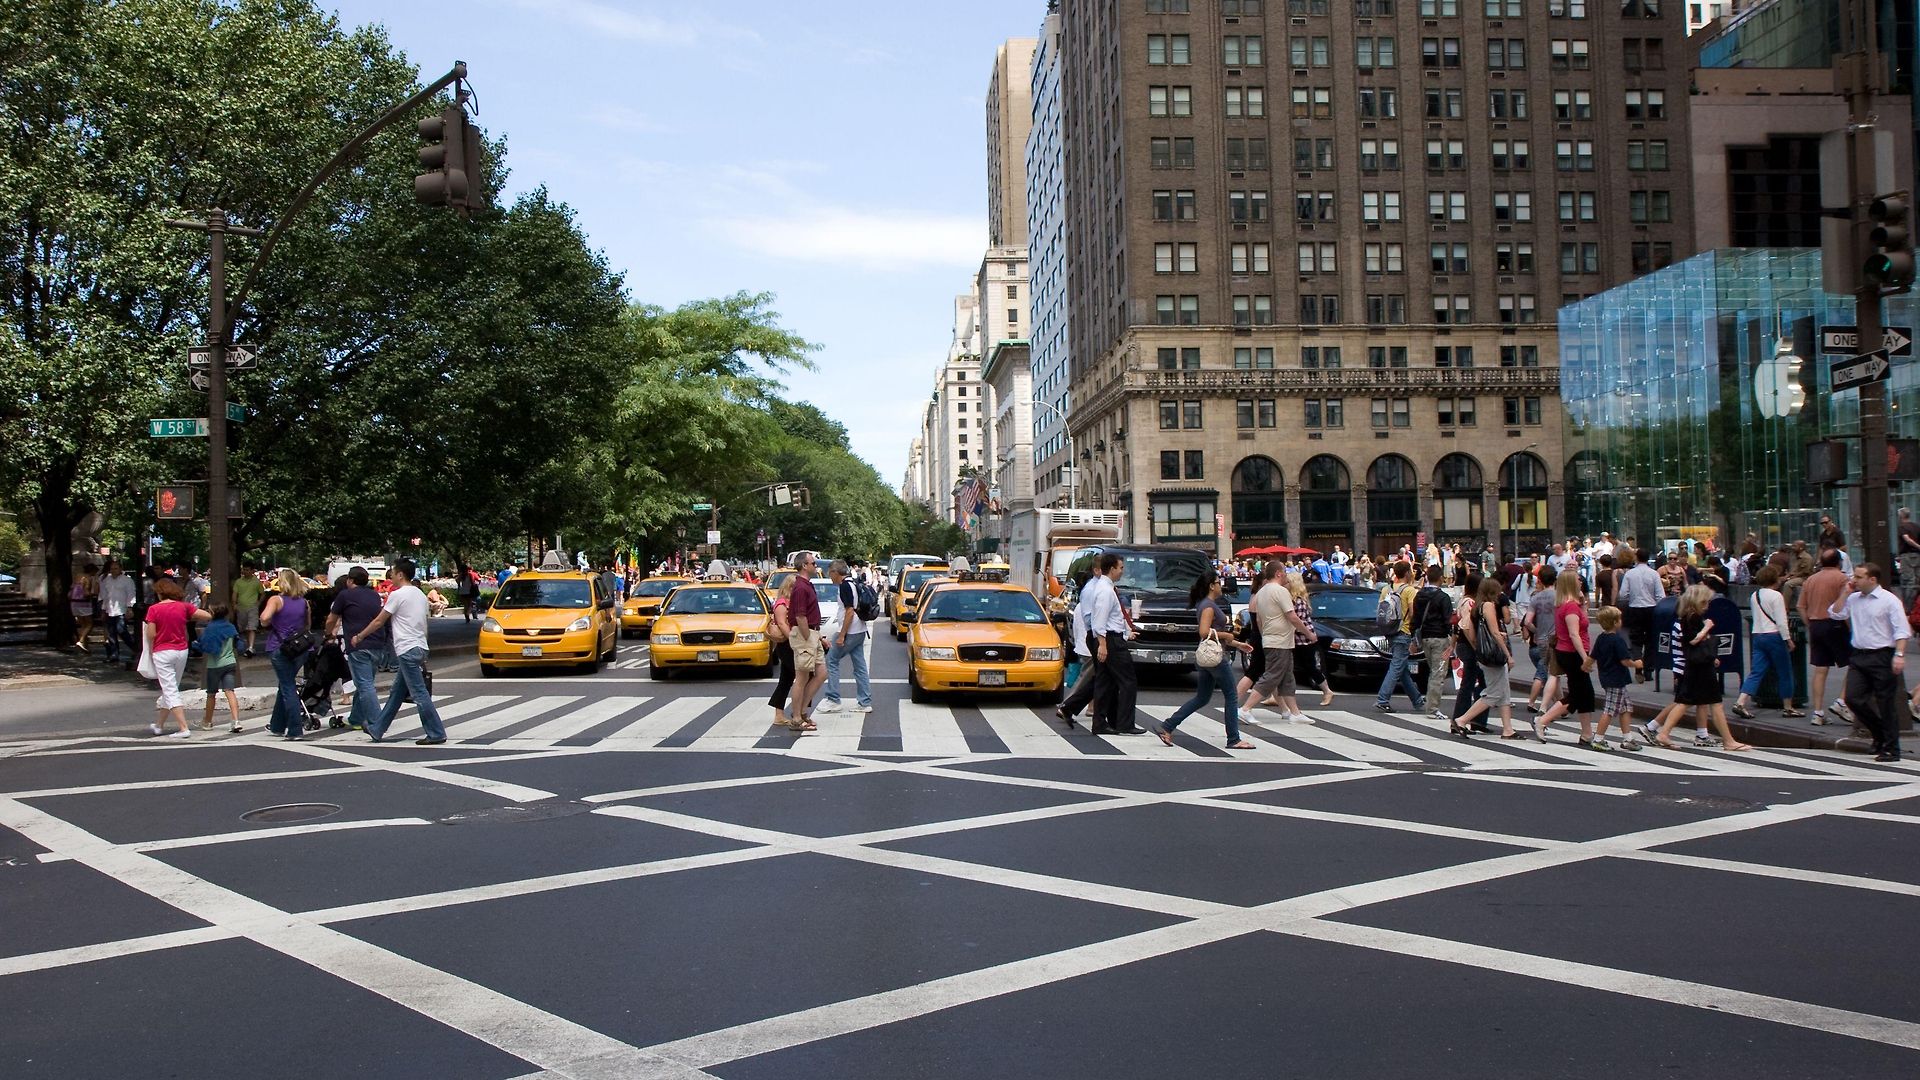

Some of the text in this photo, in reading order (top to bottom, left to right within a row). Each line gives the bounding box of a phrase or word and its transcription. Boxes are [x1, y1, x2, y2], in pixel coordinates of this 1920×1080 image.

[1833, 334, 1901, 347] ONE AY
[197, 352, 248, 362] ON WAY
[1838, 360, 1882, 382] ONE WAY
[153, 421, 163, 435] W
[168, 421, 184, 435] 58
